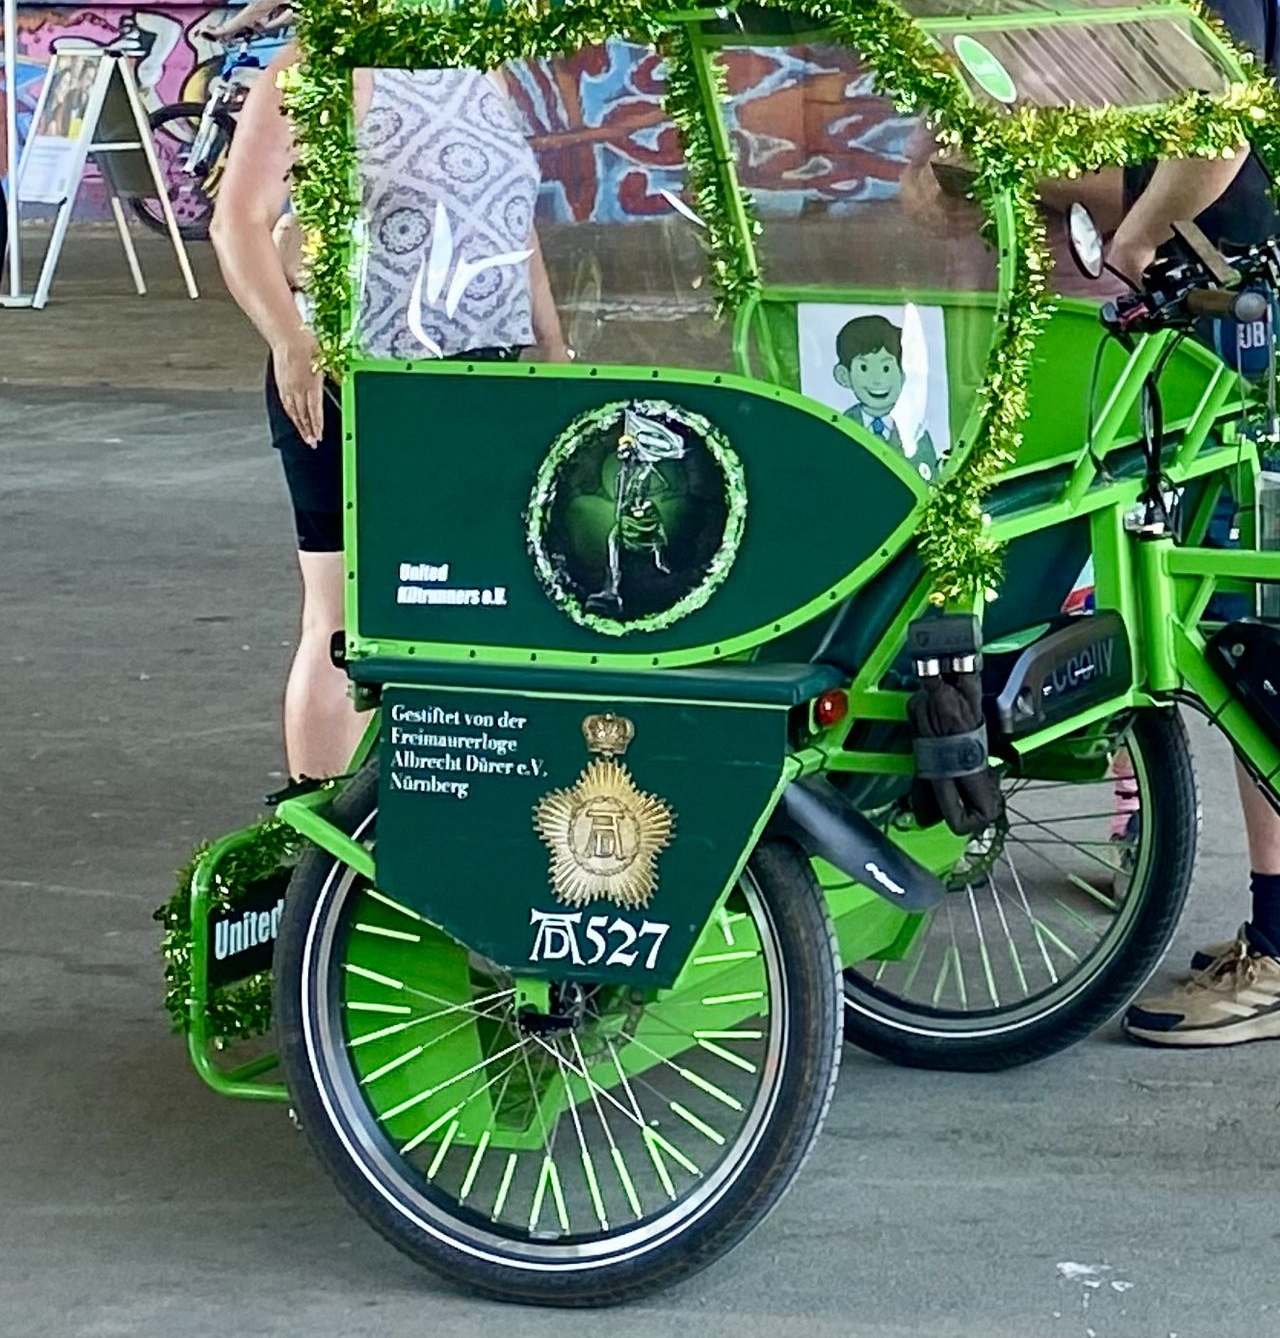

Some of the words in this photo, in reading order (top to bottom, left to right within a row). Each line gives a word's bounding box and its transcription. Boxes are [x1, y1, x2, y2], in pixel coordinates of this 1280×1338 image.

[399, 563, 449, 582] United
[391, 704, 460, 726] Gestiftet
[464, 713, 494, 728] von
[497, 711, 527, 730] der
[391, 726, 518, 756] Freimaurerloge
[390, 750, 462, 772] Albrecht
[466, 754, 514, 776] Dürer
[389, 771, 470, 800] Nürnberg
[214, 898, 285, 961] United
